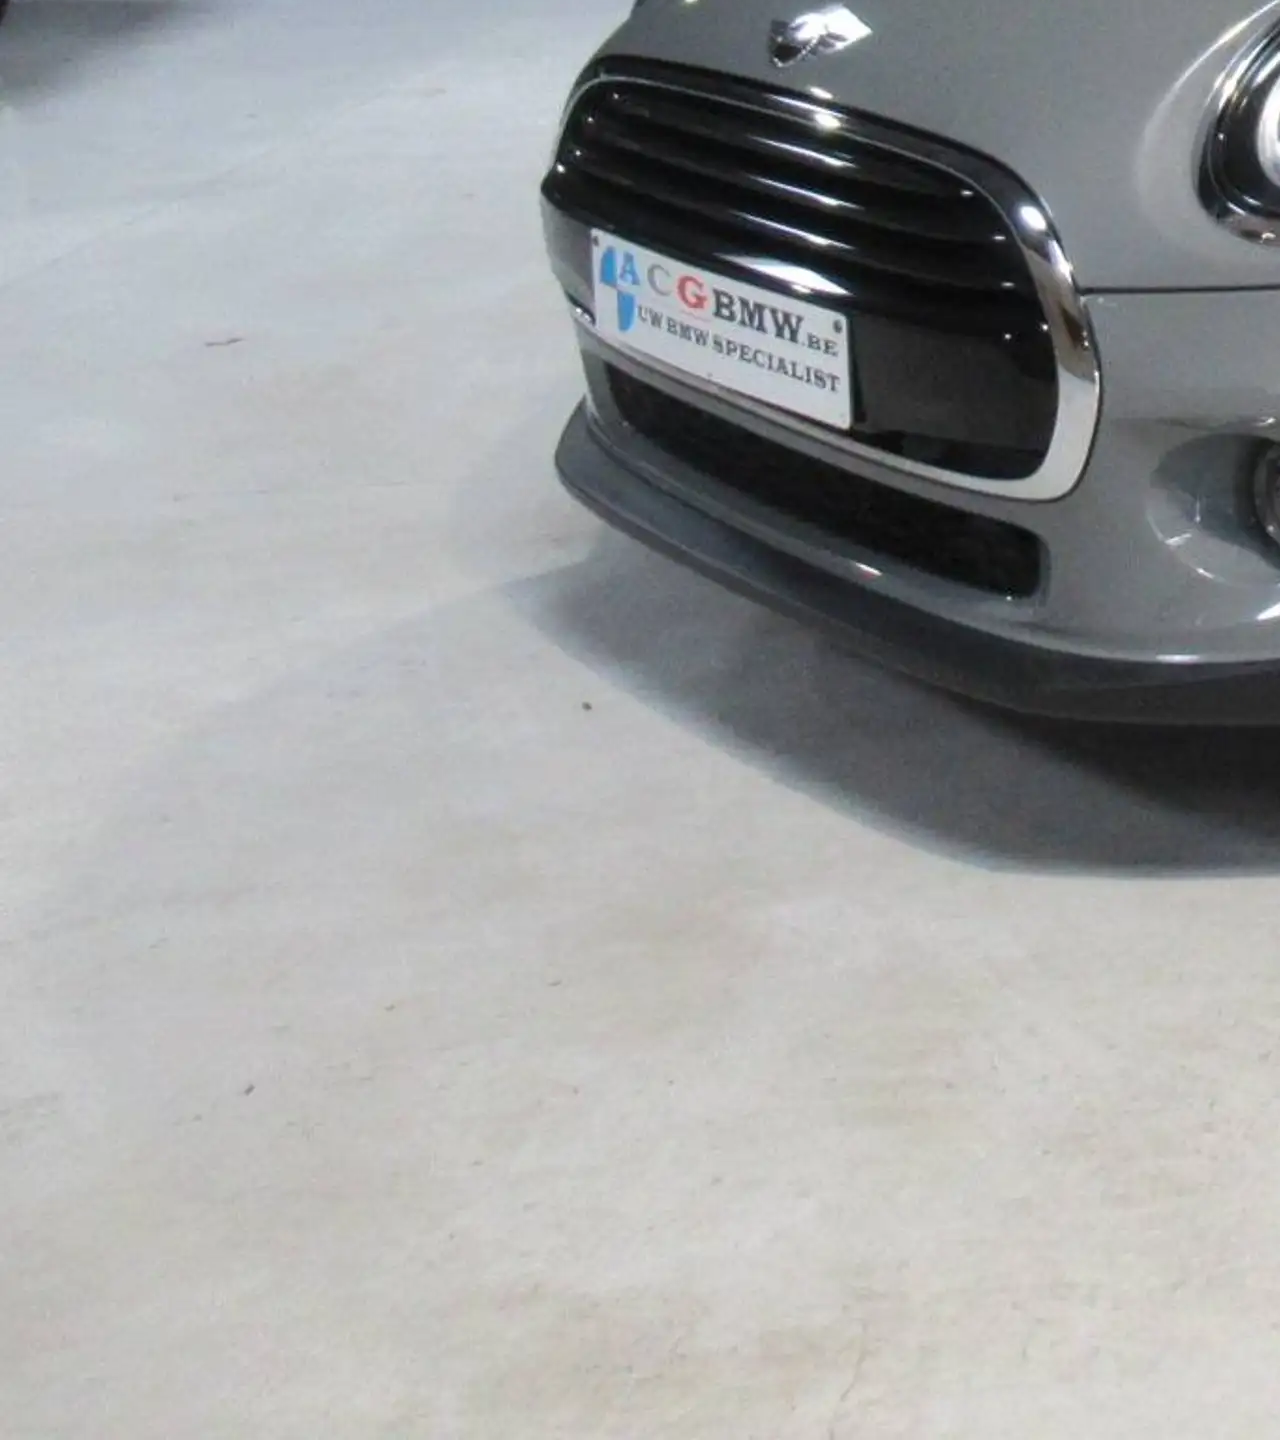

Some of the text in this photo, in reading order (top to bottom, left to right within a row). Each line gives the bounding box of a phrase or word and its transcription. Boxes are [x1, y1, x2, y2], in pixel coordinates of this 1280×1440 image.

[637, 306, 841, 393] UW BMW SPECIALIST
